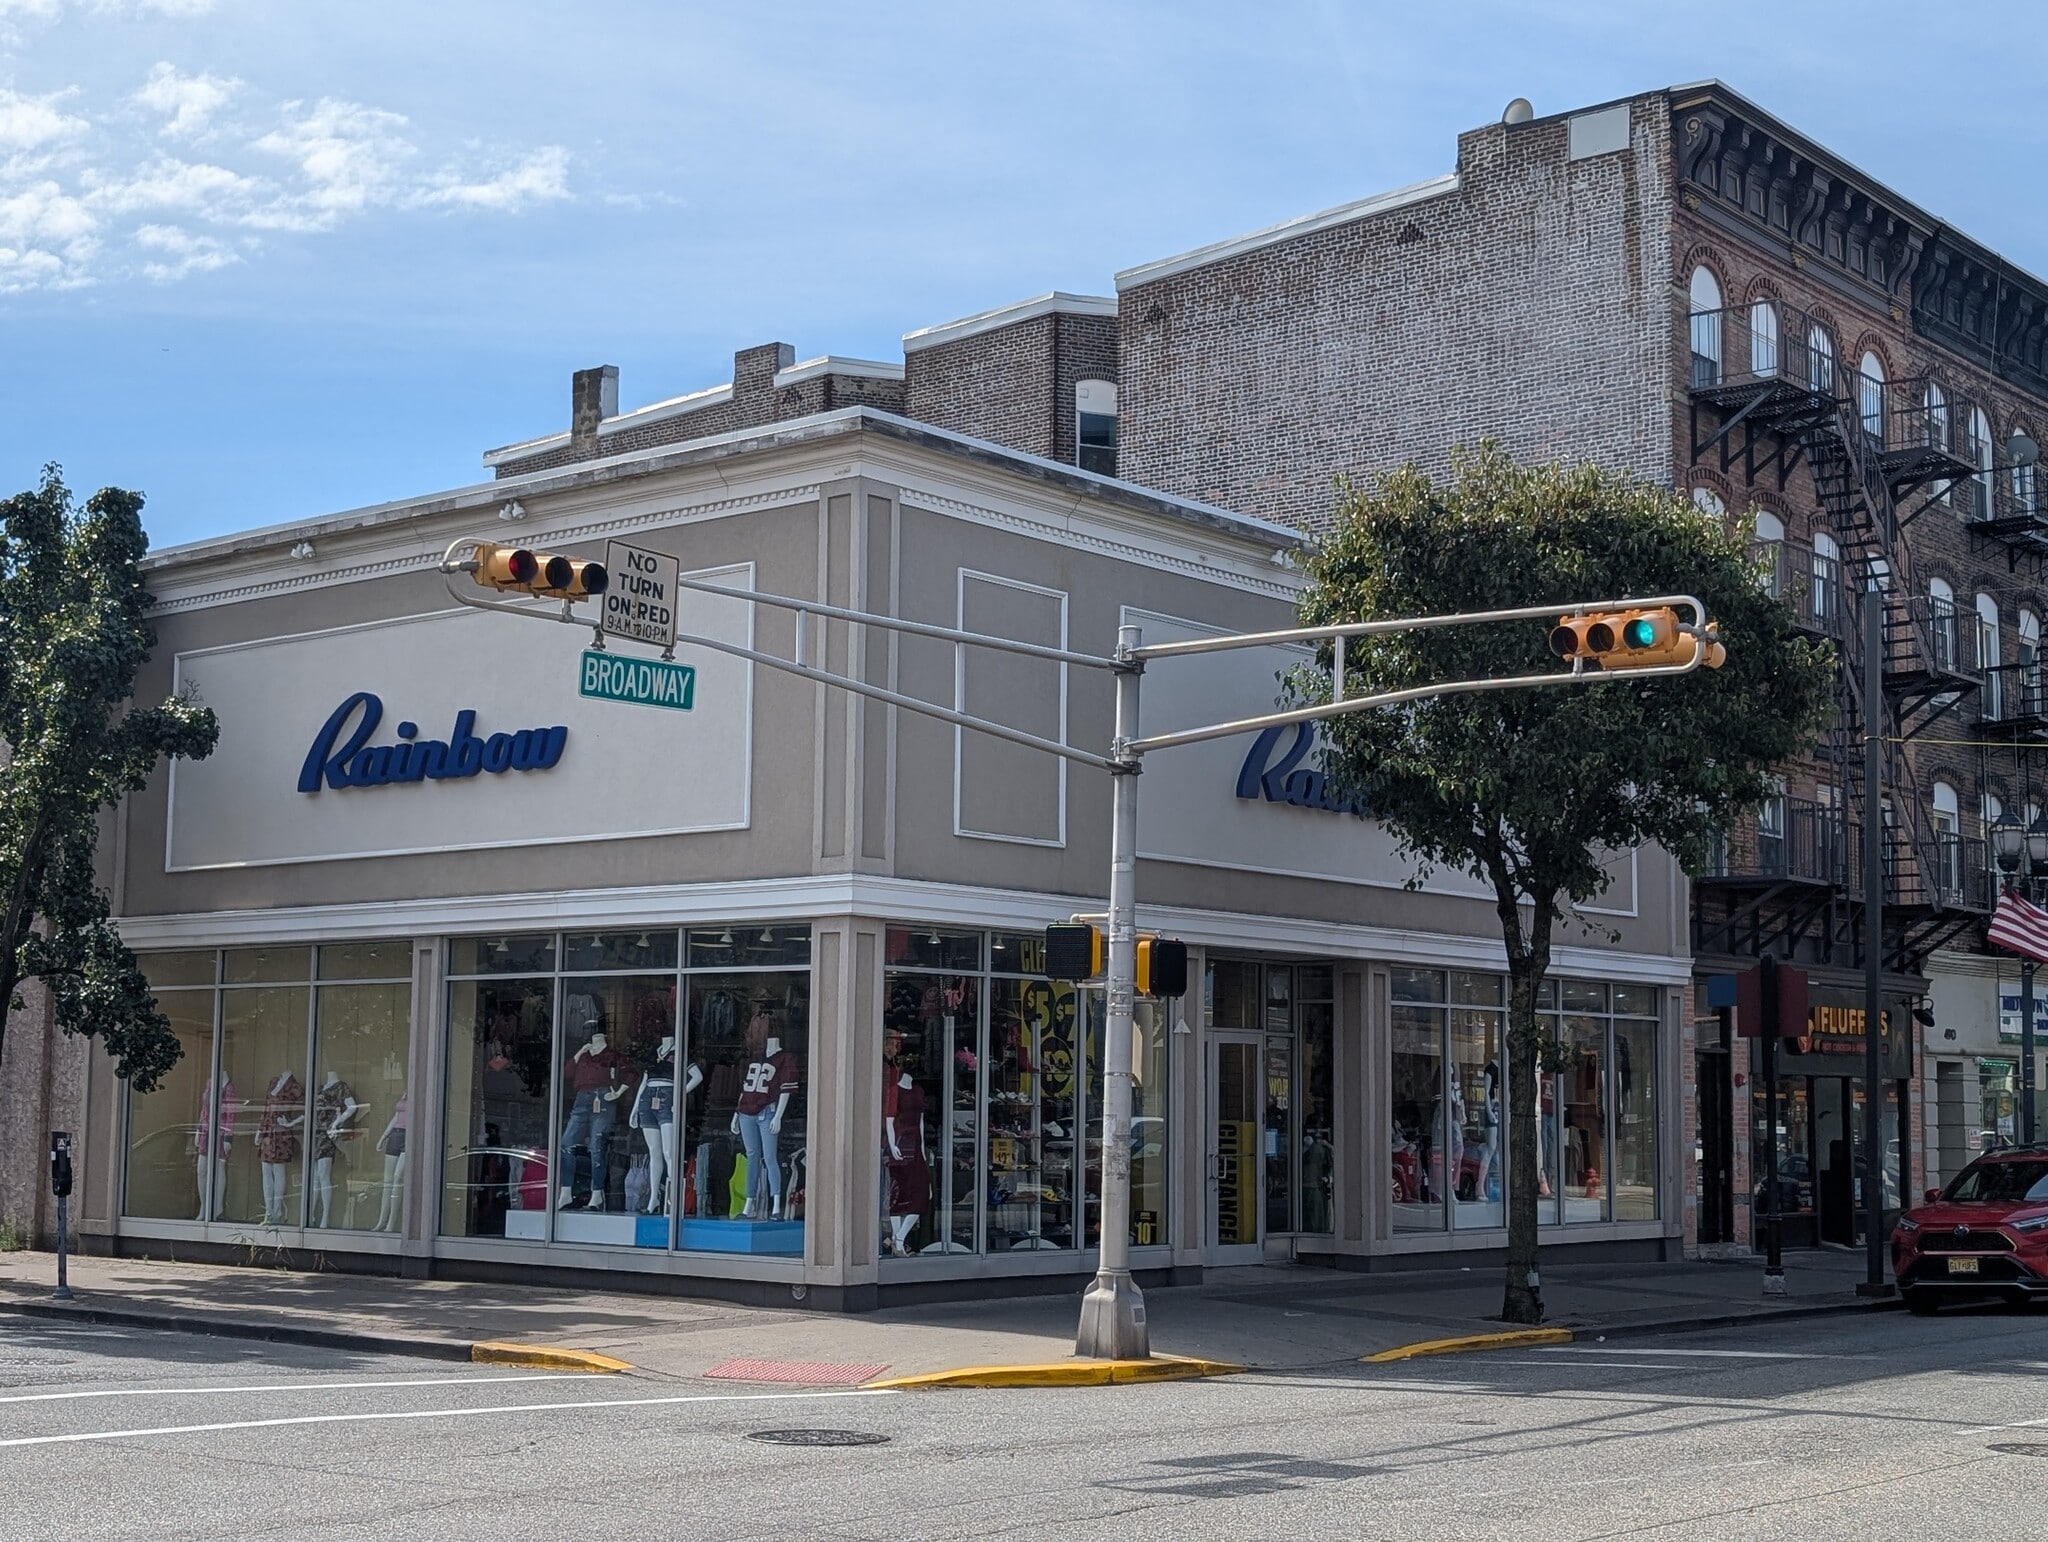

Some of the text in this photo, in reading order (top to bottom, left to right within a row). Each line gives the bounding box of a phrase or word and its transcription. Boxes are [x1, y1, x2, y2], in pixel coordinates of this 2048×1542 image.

[627, 551, 657, 574] NO
[618, 572, 665, 600] TURN
[608, 596, 670, 625] ON RED
[584, 657, 691, 704] BROADWAY
[297, 691, 568, 793] Rainbow
[743, 1063, 776, 1094] 92
